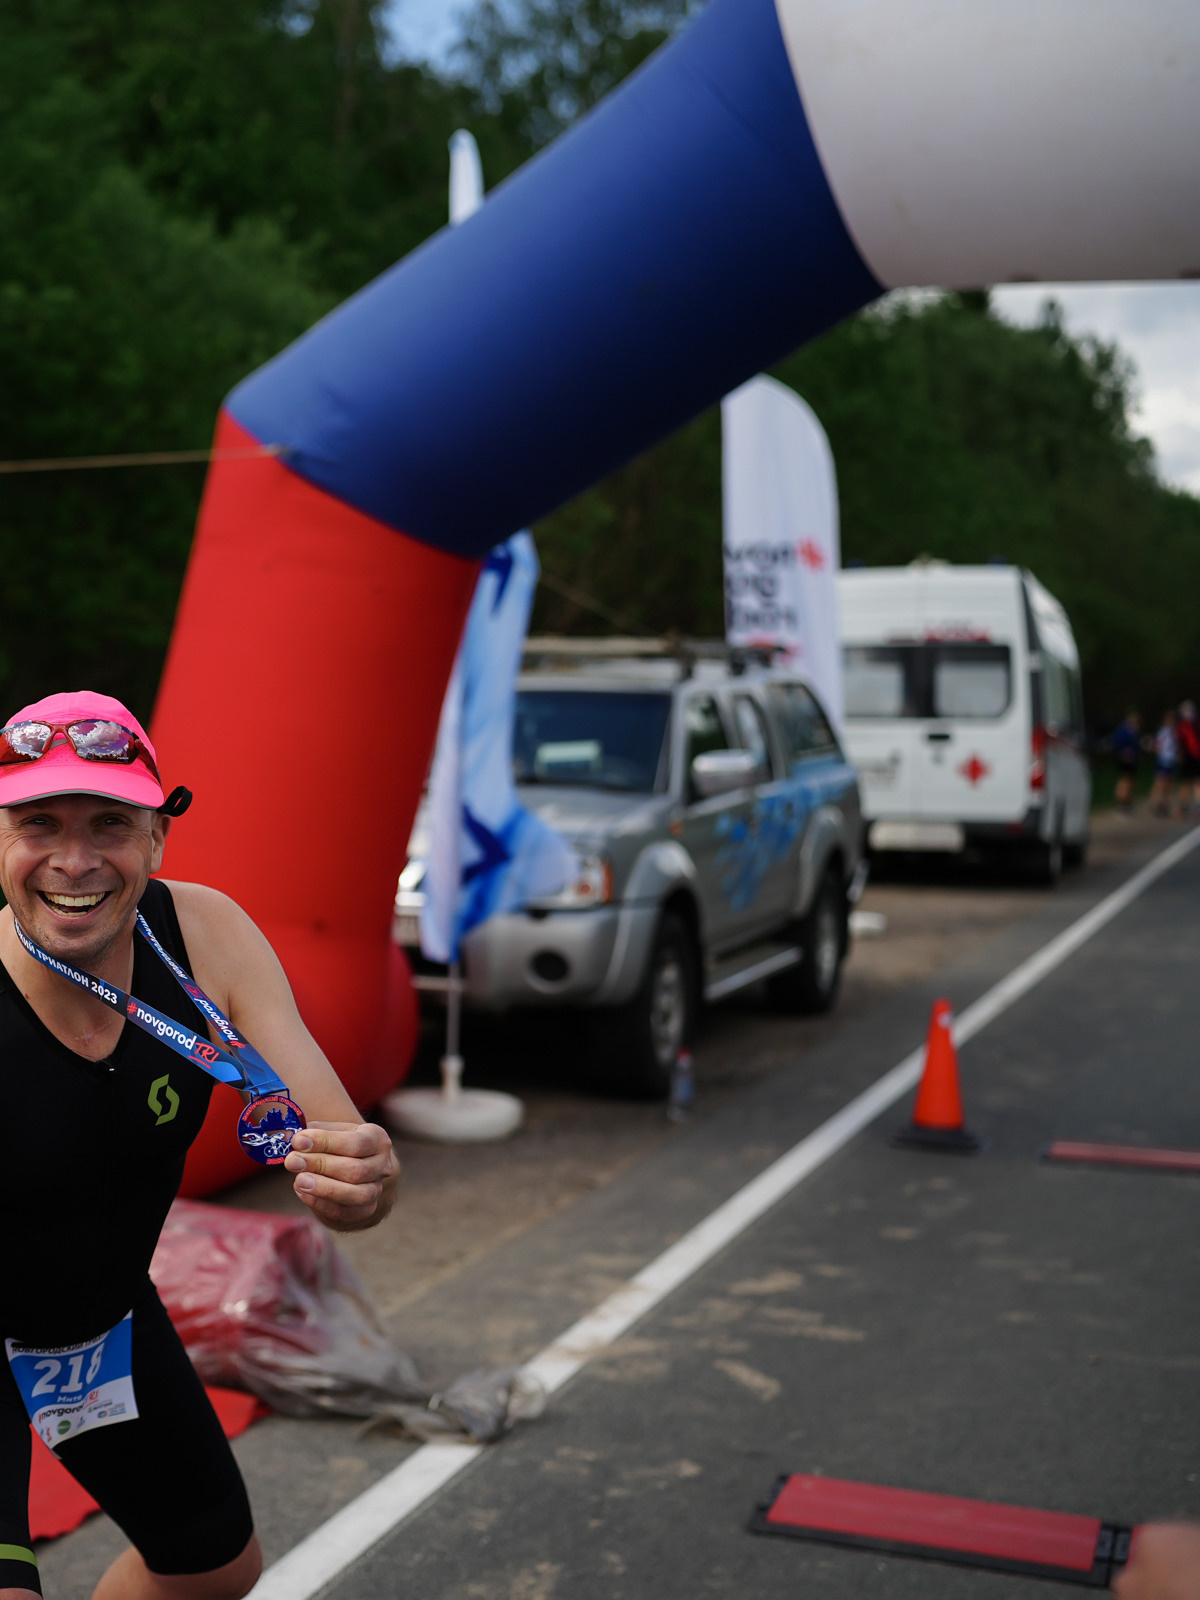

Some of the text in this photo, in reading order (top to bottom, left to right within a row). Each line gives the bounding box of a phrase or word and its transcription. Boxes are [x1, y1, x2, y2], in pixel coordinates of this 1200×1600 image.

[36, 949, 89, 987] ТРИАТЛОН
[91, 981, 118, 1005] 2023
[31, 1342, 105, 1398] 218
